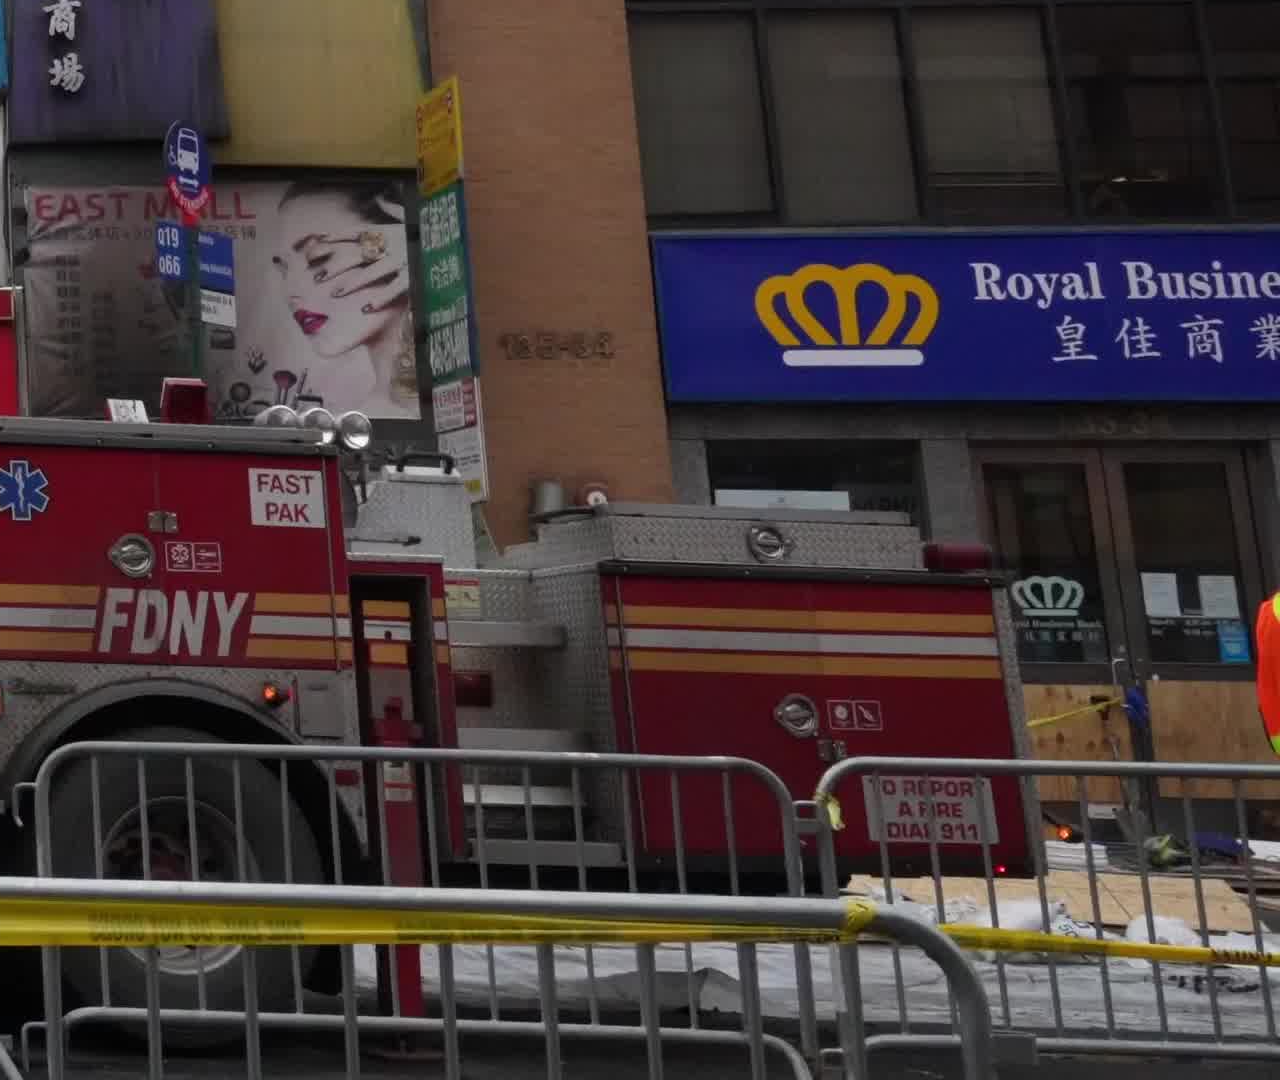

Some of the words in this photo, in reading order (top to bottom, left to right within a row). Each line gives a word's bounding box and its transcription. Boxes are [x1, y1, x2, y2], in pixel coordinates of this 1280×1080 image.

[34, 192, 130, 220] EAST
[143, 192, 257, 220] MLL
[969, 261, 1106, 309] Royal
[1121, 260, 1280, 302] Busine
[256, 473, 314, 495] FAST
[264, 502, 310, 523] PAK
[98, 586, 249, 657] FDNY
[897, 801, 913, 818] A
[941, 822, 979, 840] 911
